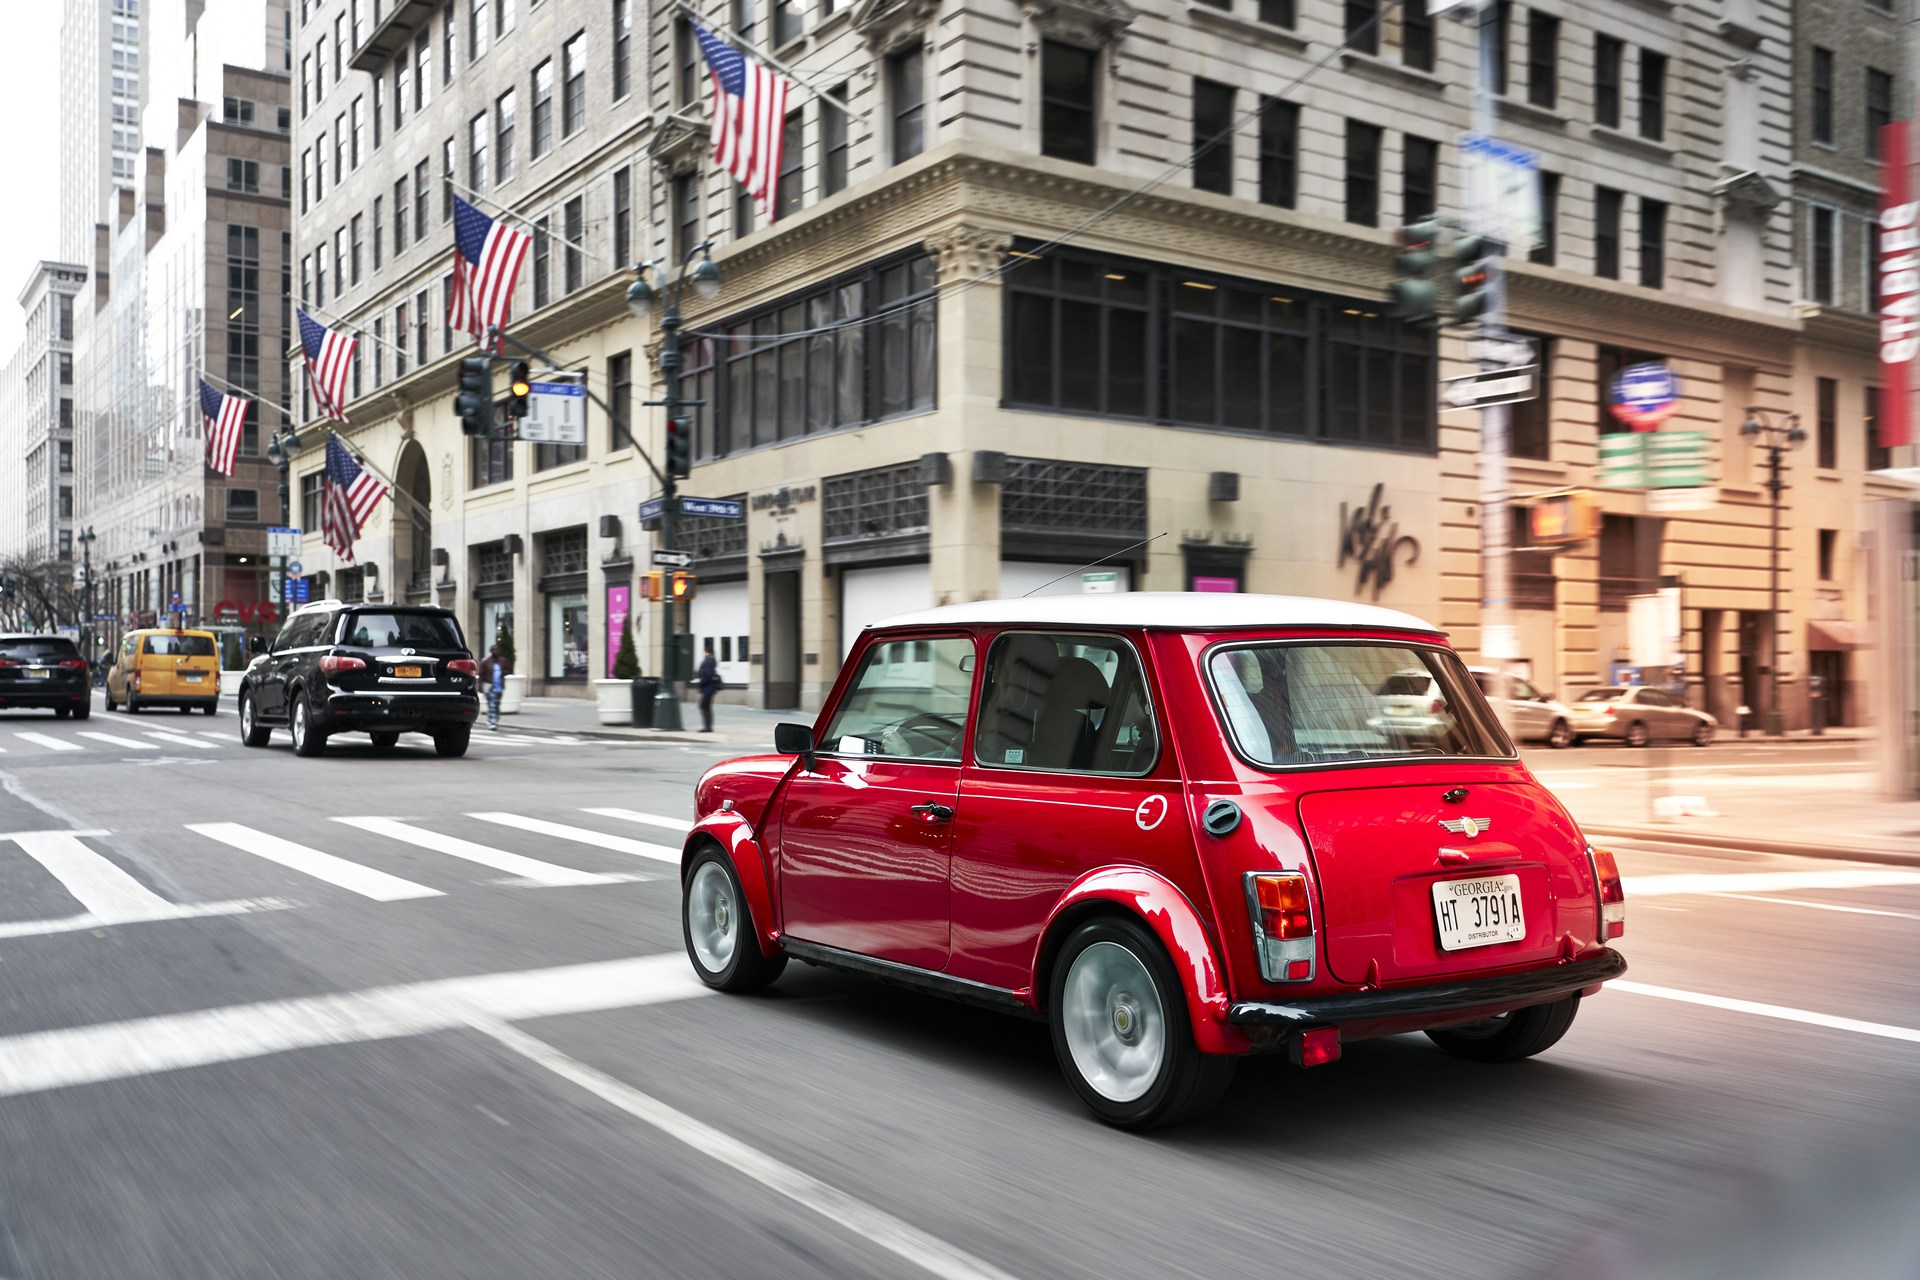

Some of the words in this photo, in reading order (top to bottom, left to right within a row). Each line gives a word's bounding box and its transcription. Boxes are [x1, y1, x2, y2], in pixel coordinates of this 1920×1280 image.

[213, 600, 277, 623] CVS
[1440, 899, 1459, 932] HT
[1471, 893, 1520, 927] 3791A
[1468, 930, 1499, 940] DISTRIBUTOR
